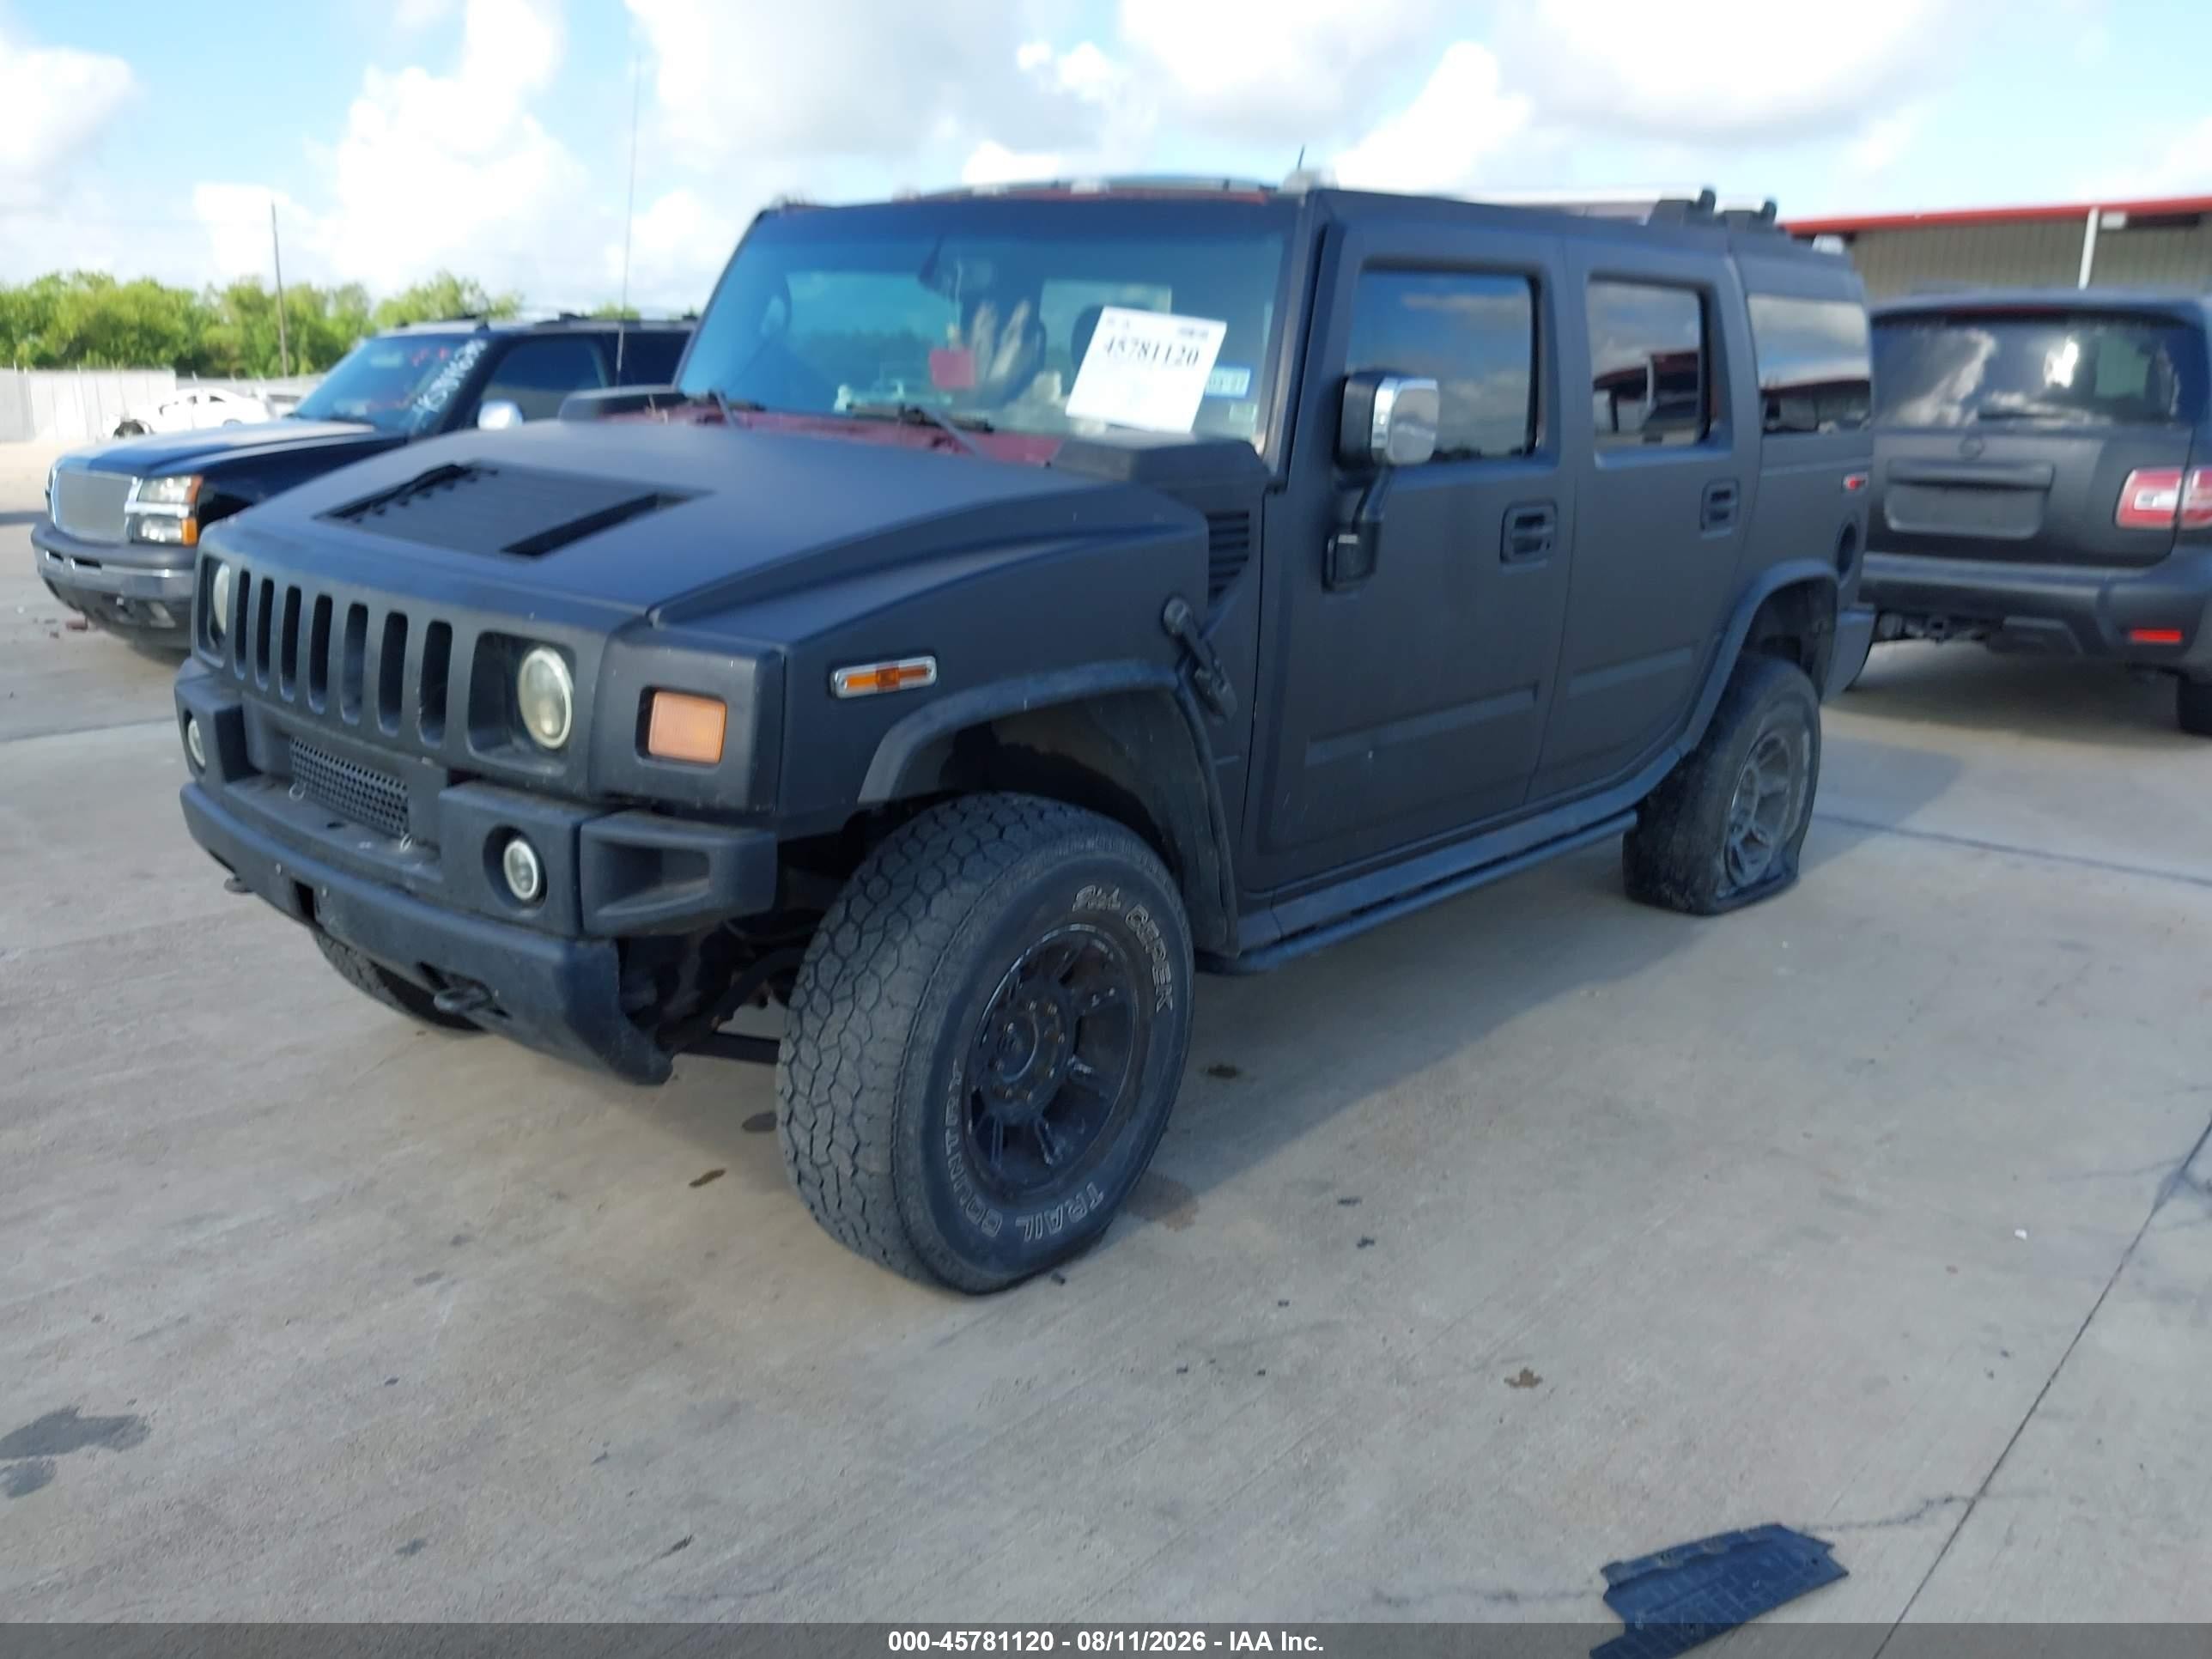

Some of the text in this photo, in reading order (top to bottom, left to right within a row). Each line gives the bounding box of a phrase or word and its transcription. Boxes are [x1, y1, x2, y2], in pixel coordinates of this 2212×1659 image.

[1105, 337, 1200, 366] 45781120
[945, 1058, 1104, 1242] TRAIL COUNTRY
